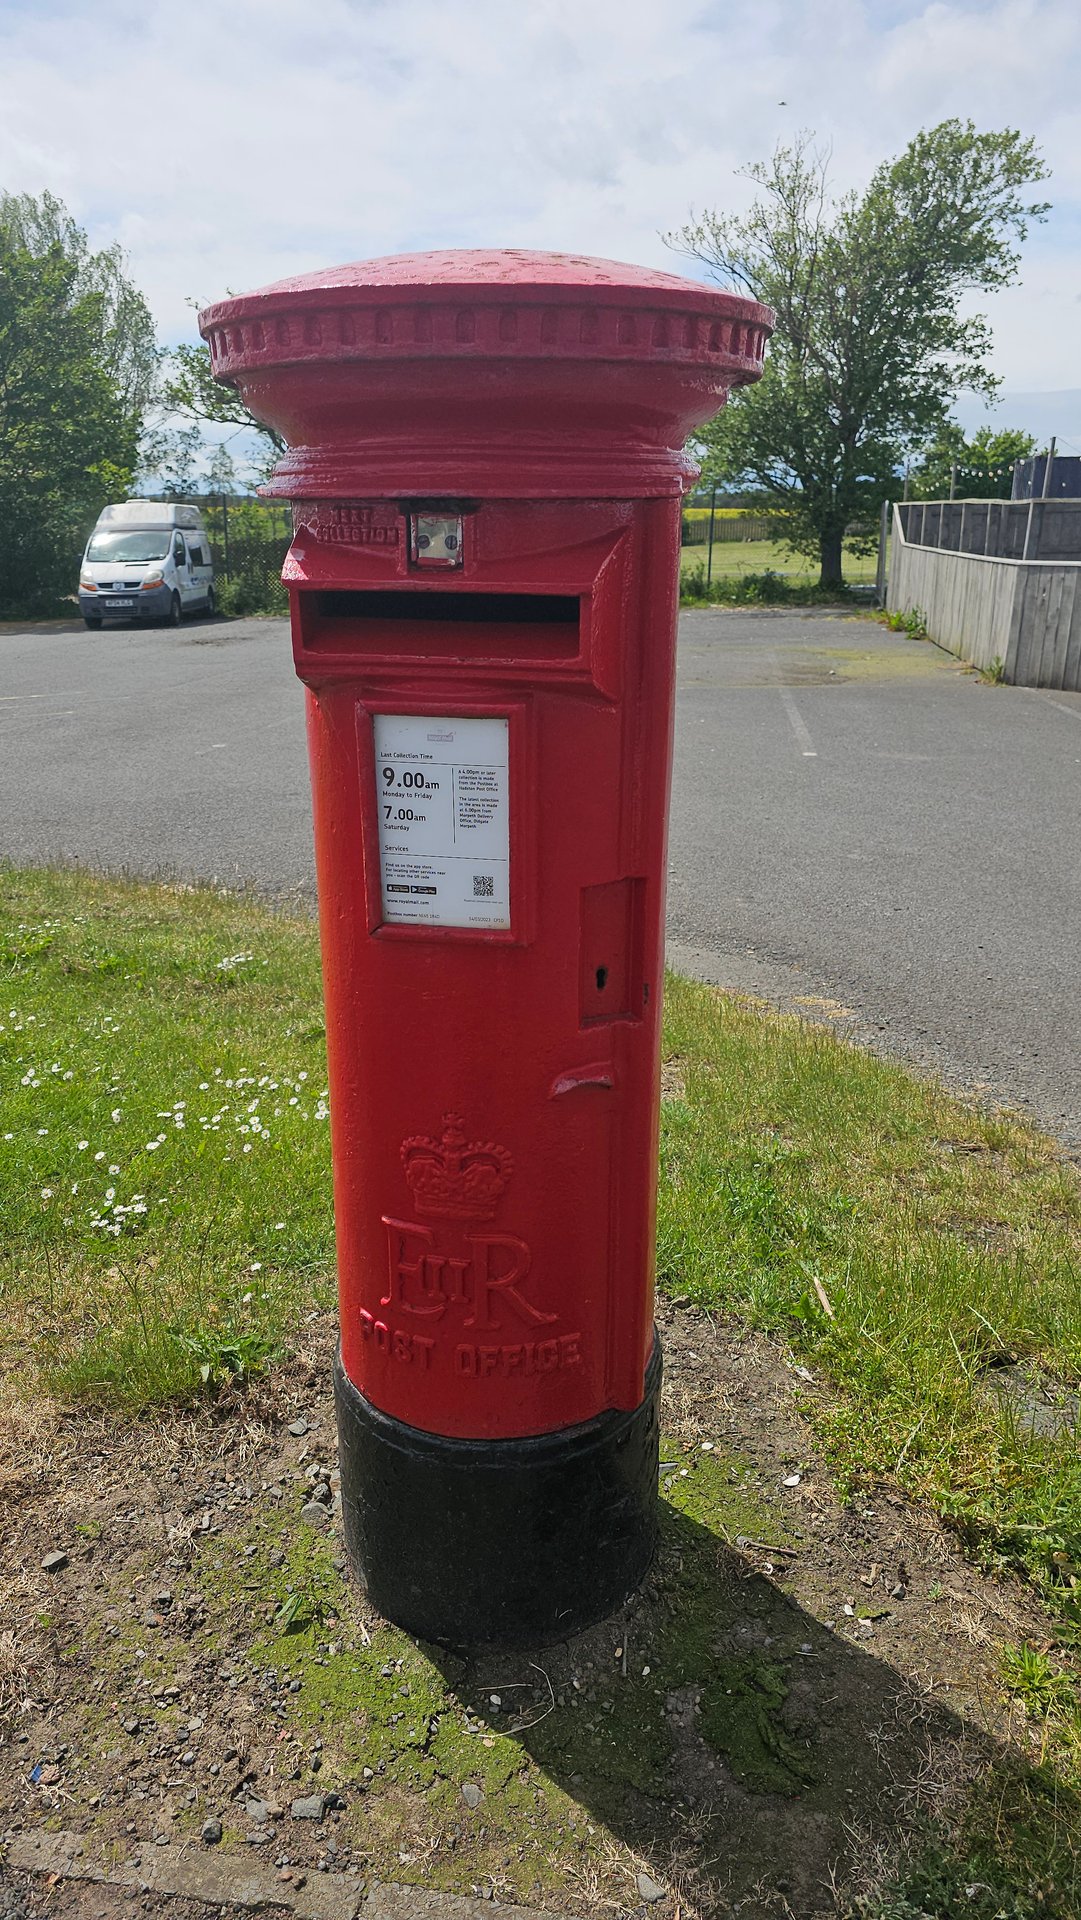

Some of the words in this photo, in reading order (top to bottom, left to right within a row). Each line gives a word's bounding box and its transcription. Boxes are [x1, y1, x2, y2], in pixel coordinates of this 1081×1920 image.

[382, 767, 440, 789] 9.00am
[384, 805, 426, 821] 7.00am
[359, 1307, 435, 1370] POST
[456, 1333, 581, 1378] OFFICE
